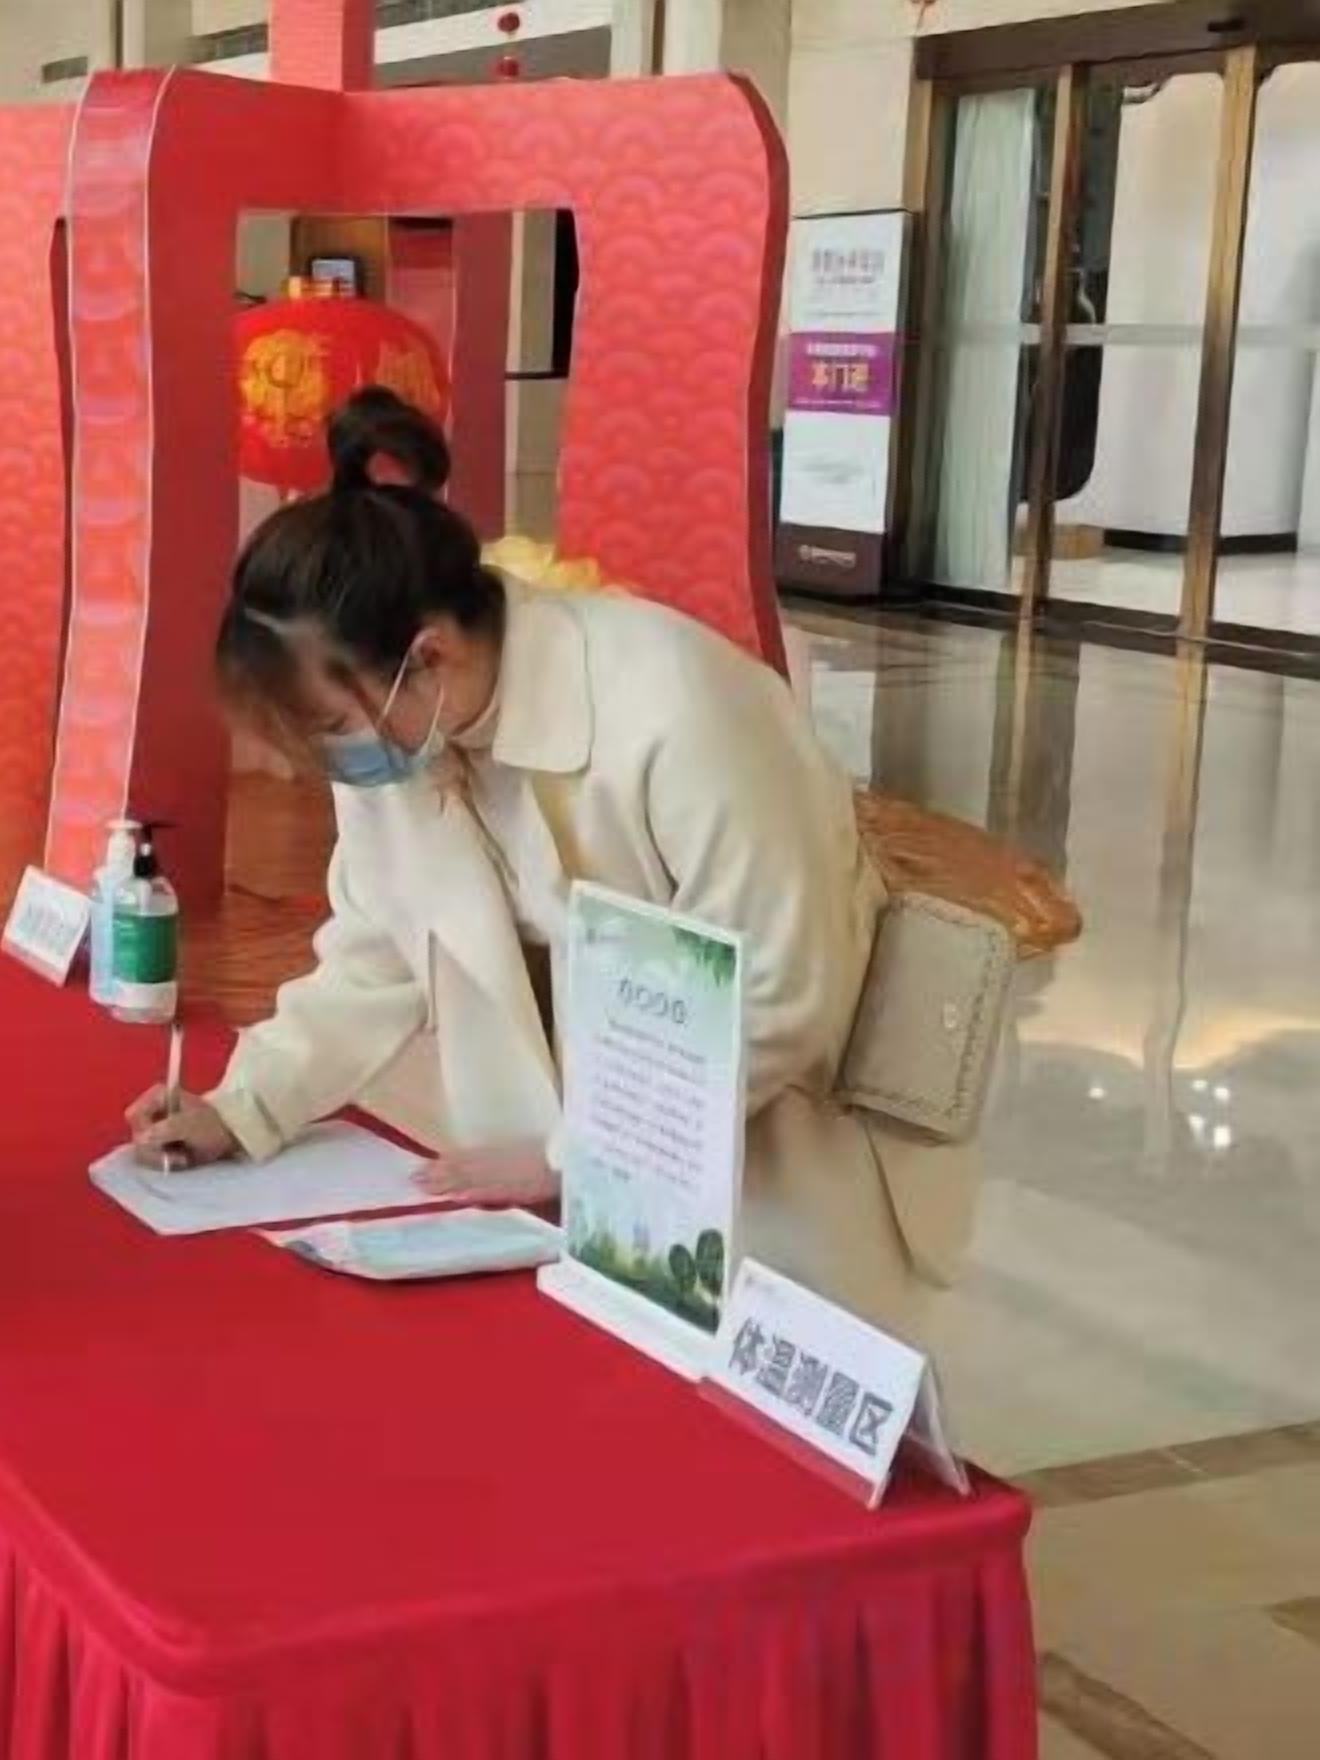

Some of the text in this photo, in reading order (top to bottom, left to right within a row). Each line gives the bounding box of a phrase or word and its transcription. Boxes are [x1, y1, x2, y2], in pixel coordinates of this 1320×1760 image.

[730, 1318, 893, 1455] 体温测量区
